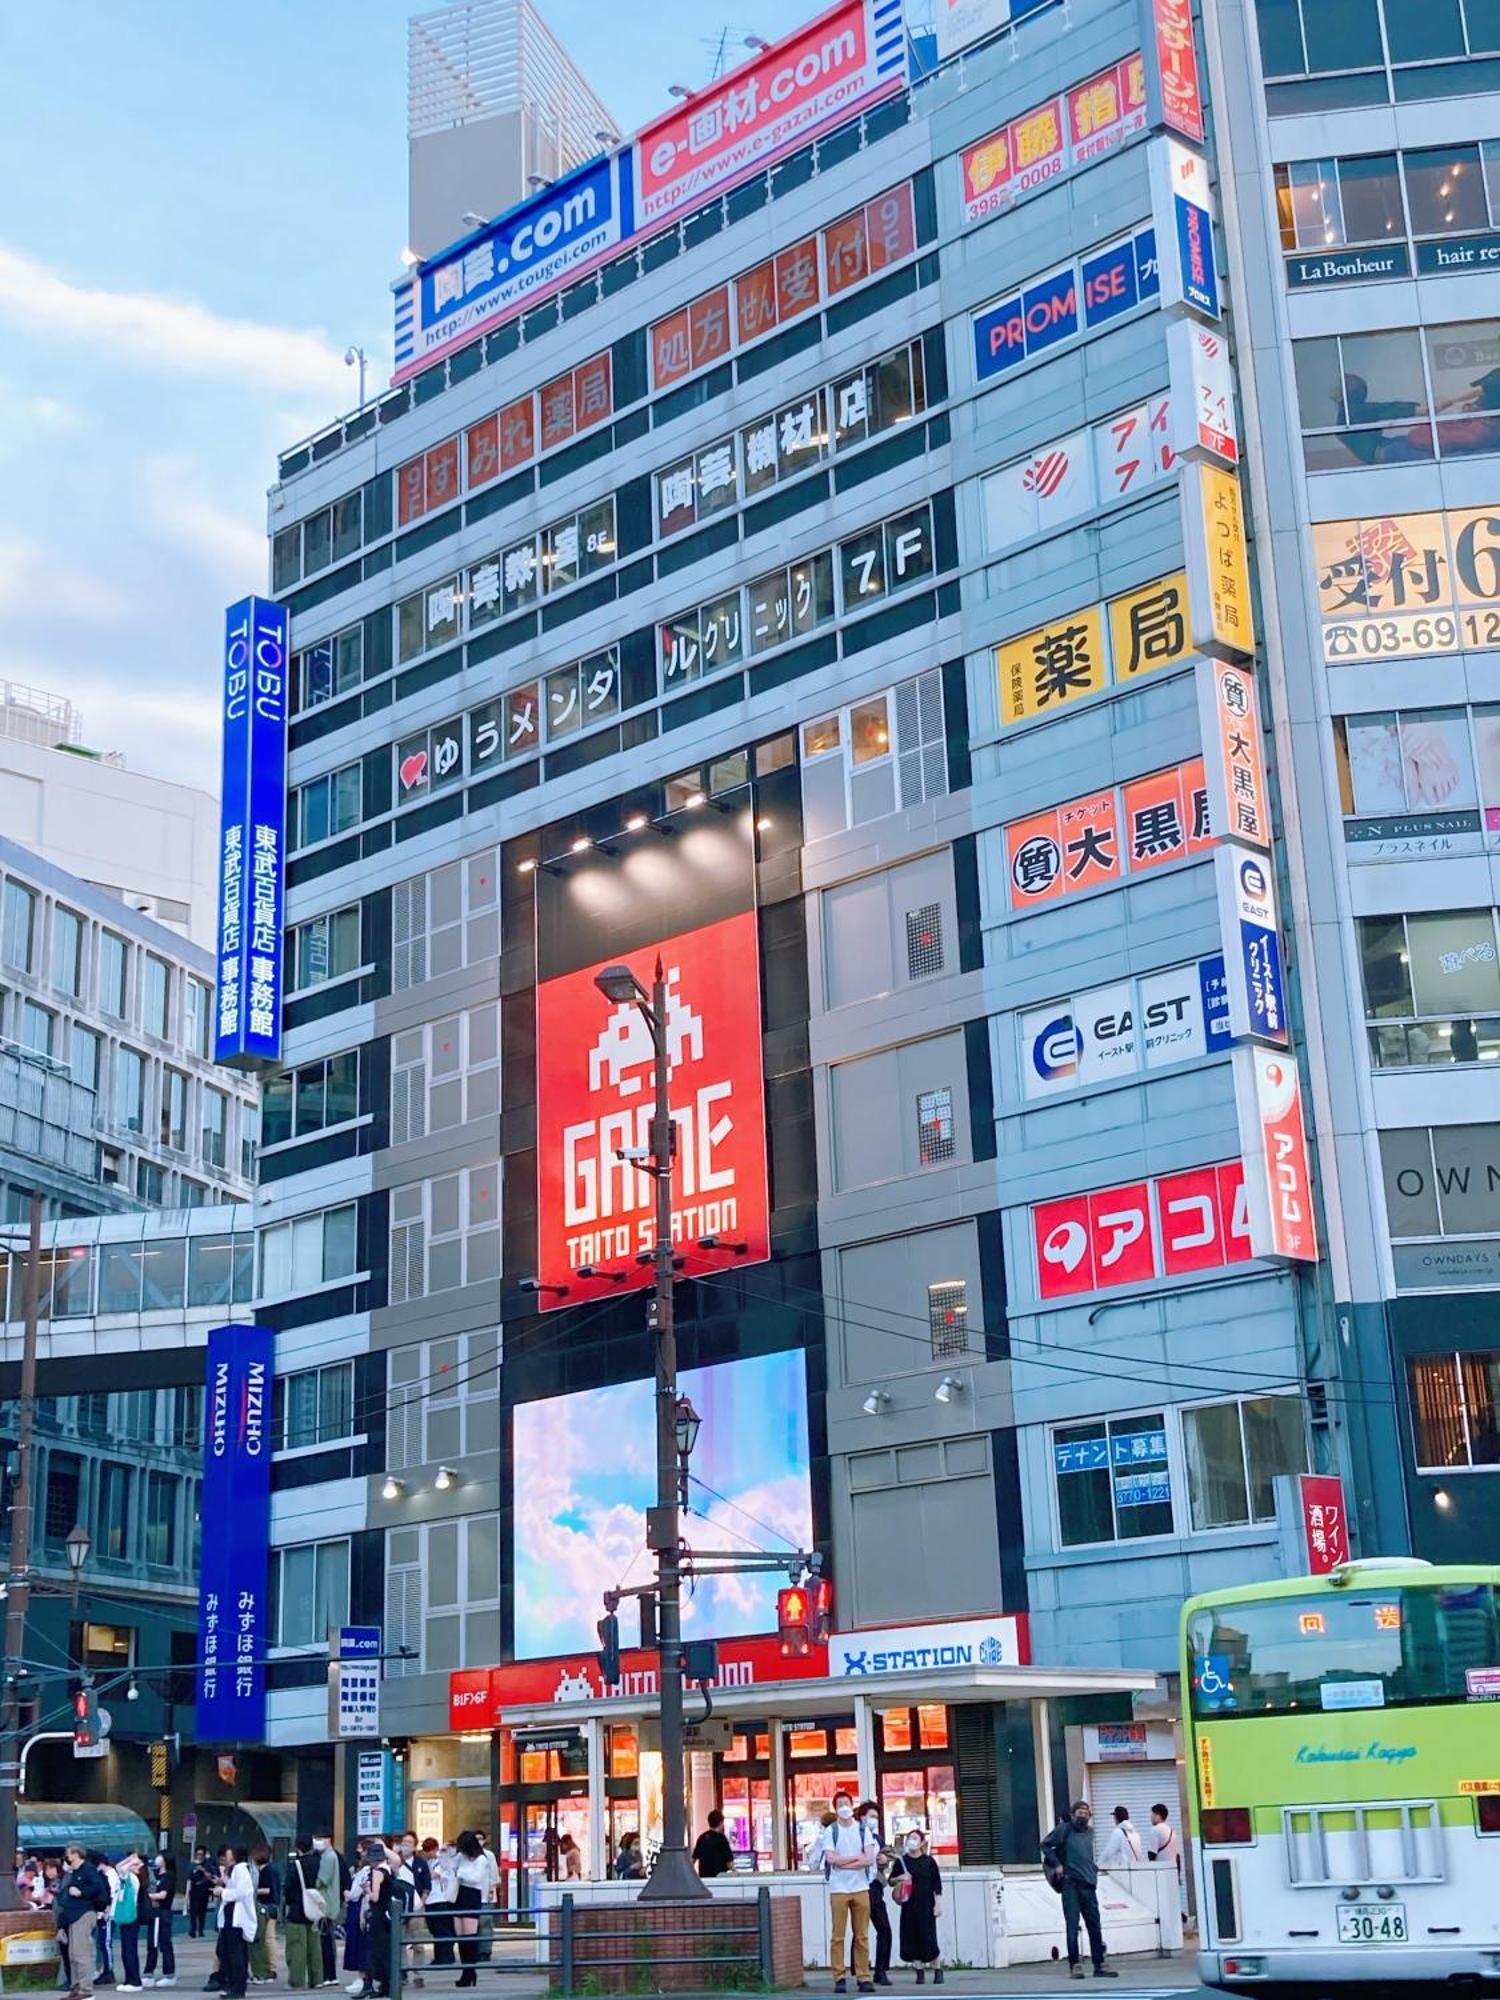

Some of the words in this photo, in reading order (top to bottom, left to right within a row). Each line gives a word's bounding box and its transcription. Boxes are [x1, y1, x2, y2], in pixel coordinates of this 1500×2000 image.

[643, 75, 865, 216] http://www.e-gazai.com
[650, 29, 856, 177] e-画材.com
[426, 229, 607, 346] http://www.tougei.com
[658, 230, 865, 381] 処方せん受付
[1437, 247, 1474, 266] hair
[990, 263, 1126, 357] PROMISE
[432, 368, 607, 495] すみれ薬局
[1214, 491, 1239, 627] よつば薬局
[227, 620, 248, 720] TOBU
[256, 623, 283, 722] TOBU
[1032, 588, 1184, 707] 薬局
[1064, 801, 1110, 822] チケット
[1229, 732, 1259, 837] 大黒屋
[222, 825, 242, 952] 東武百貨店
[251, 825, 278, 953] 東武百貨店
[219, 955, 239, 1036] 事務館
[249, 956, 276, 1037] 事務館
[1094, 995, 1191, 1040] EAST
[564, 1080, 735, 1228] GAME
[1273, 1132, 1302, 1224] アコム
[566, 1227, 630, 1269] TAITO
[1422, 1252, 1489, 1266] OWNDAYS
[213, 1362, 228, 1457] MIZUHO
[246, 1361, 265, 1456] MIZUHO
[1057, 1435, 1167, 1468] テナント募集
[1325, 1506, 1344, 1566] ワイン
[204, 1594, 219, 1699] みずほ銀行
[236, 1591, 256, 1698] みずほ銀行
[1349, 1916, 1404, 1939] 30-48
